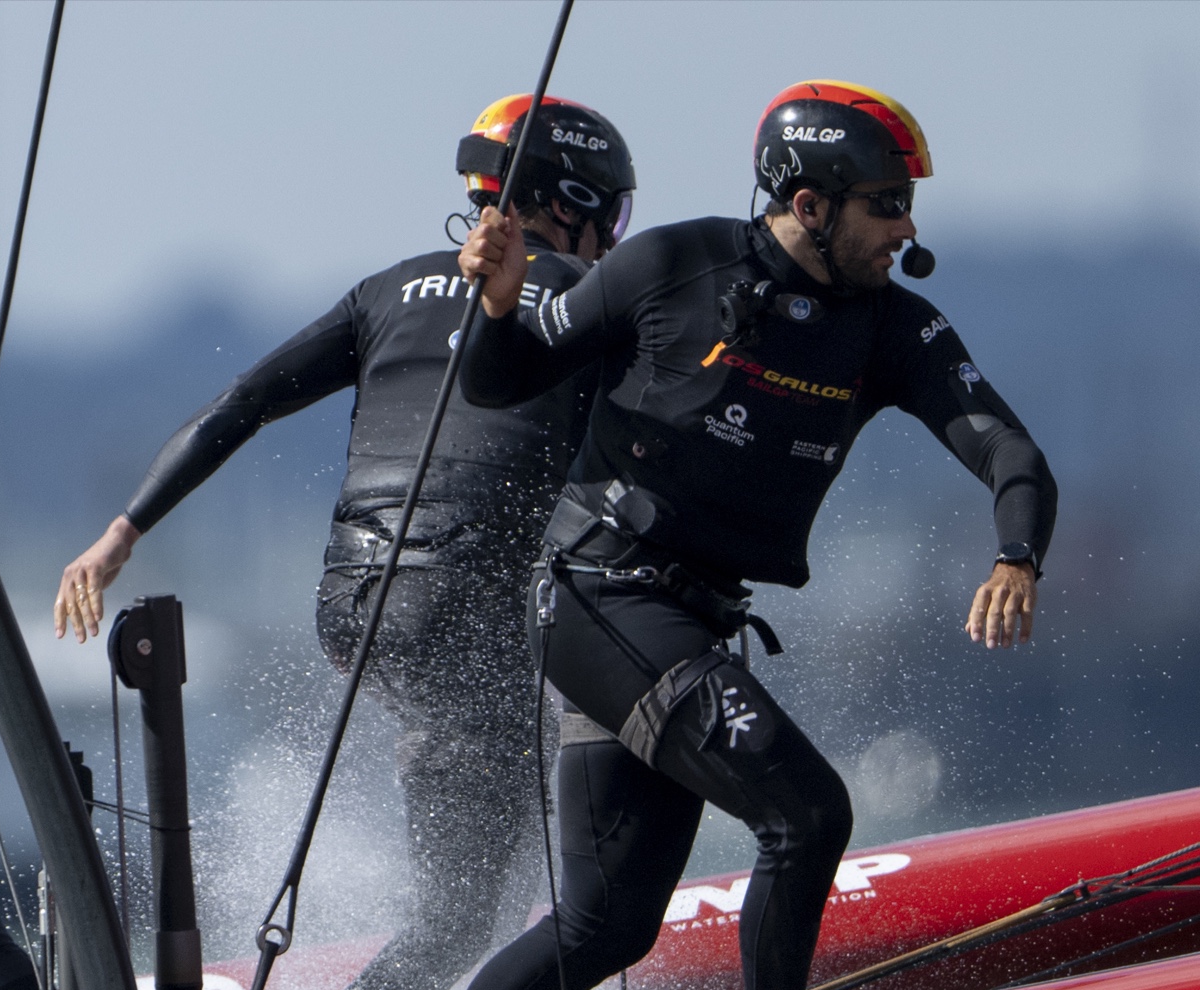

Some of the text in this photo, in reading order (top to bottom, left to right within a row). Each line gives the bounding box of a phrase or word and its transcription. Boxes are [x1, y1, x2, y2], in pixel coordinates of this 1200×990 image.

[715, 353, 853, 400] OSGALLOS
[704, 414, 755, 442] Quantum
[705, 425, 746, 447] Pacific
[827, 889, 877, 906] TION
